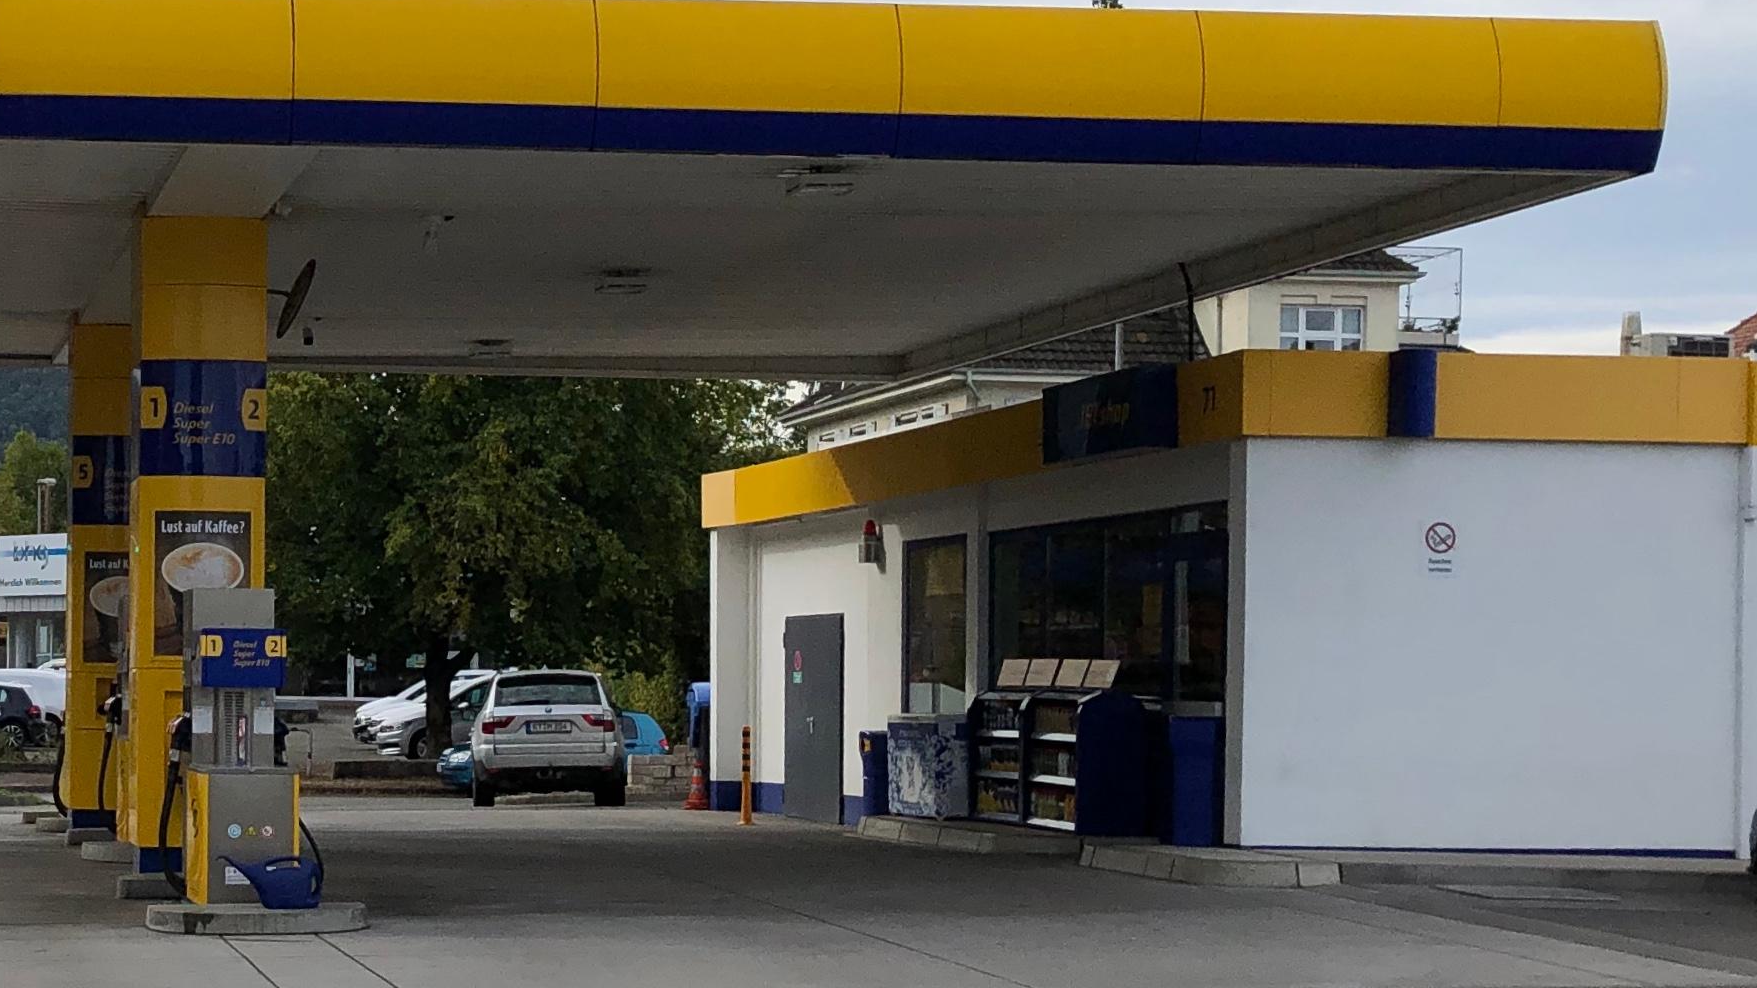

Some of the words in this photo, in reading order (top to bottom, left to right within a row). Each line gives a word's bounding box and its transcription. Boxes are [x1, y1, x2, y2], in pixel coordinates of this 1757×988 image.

[149, 398, 158, 417] 1
[174, 401, 214, 414] Diesel
[248, 399, 260, 420] 2
[173, 417, 211, 432] Super
[172, 432, 211, 447] Super
[212, 433, 235, 444] E10
[79, 463, 88, 479] 5
[161, 519, 182, 533] Lust
[185, 519, 203, 533] auf
[204, 519, 245, 533] Kaffee?
[211, 639, 216, 652] 1
[270, 640, 278, 652] 2
